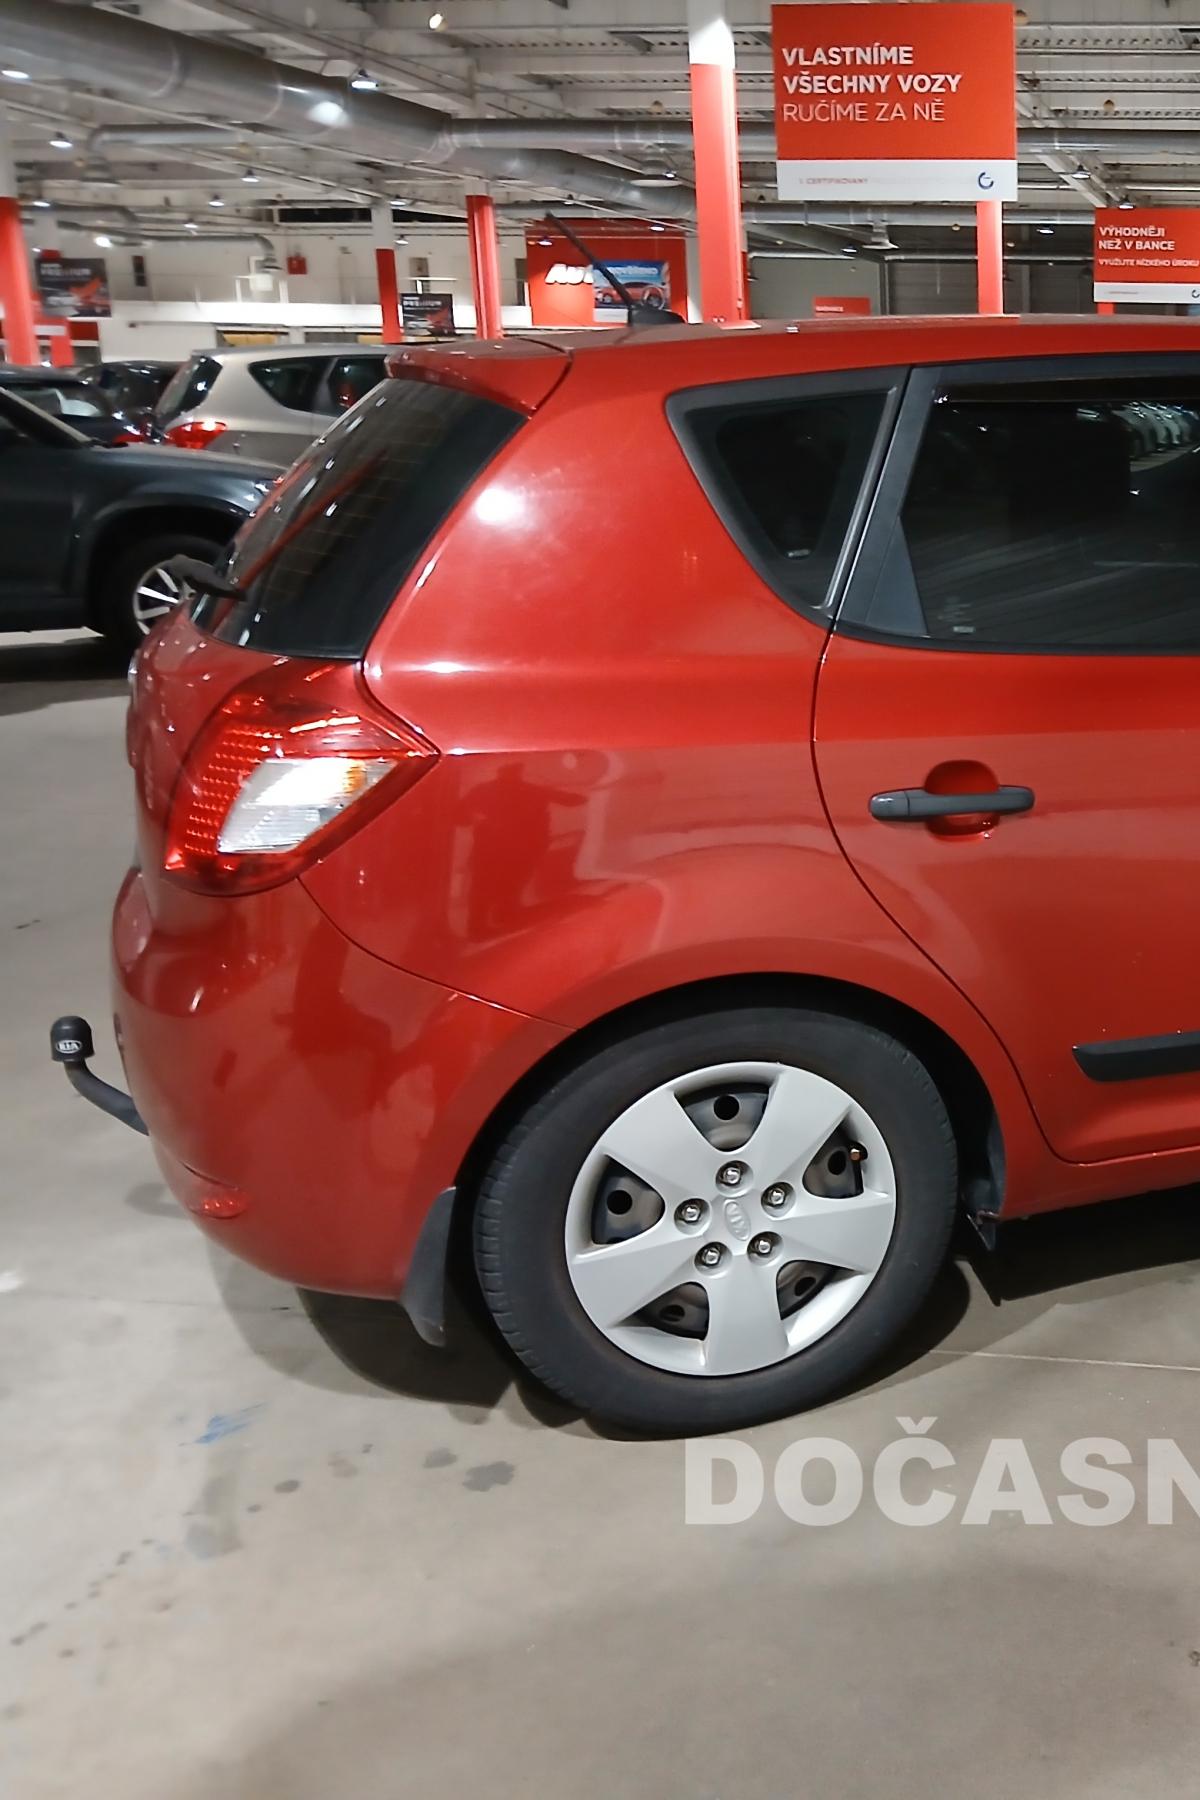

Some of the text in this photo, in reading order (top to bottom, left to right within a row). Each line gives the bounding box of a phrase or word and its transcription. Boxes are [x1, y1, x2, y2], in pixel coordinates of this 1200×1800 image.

[781, 43, 914, 66] VLASTNÍME
[783, 72, 962, 94] VŠECHNY VOZY
[782, 99, 945, 122] RUČÍME ZA NĚ
[1099, 225, 1165, 237] VÝHODNĚJI
[1098, 239, 1175, 250] NEŽ V BANCE
